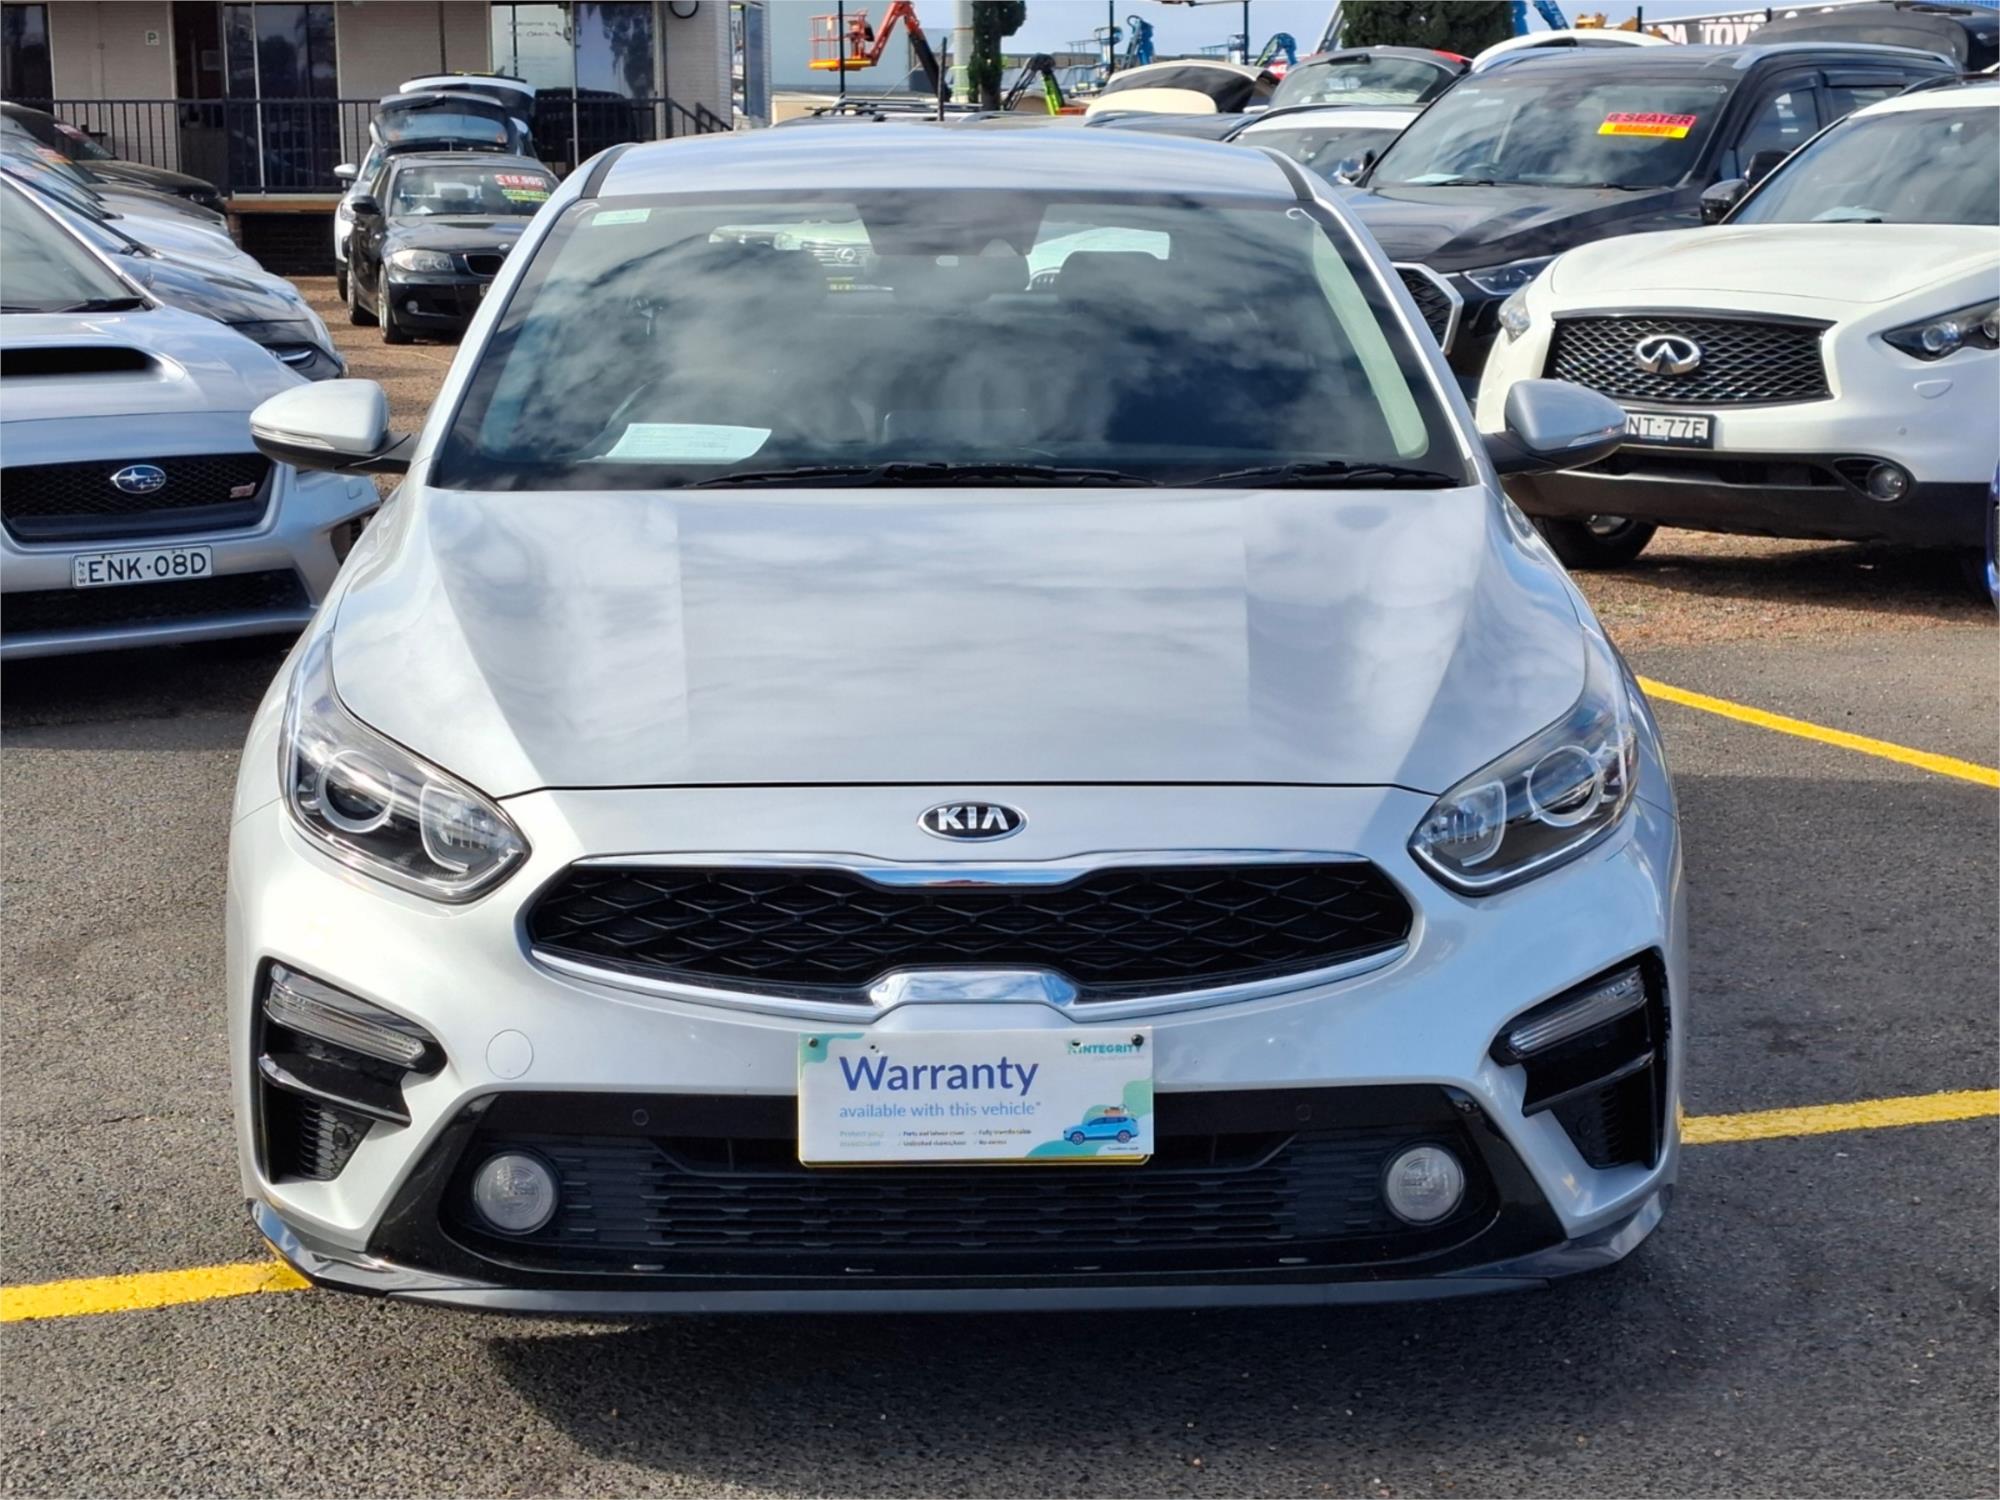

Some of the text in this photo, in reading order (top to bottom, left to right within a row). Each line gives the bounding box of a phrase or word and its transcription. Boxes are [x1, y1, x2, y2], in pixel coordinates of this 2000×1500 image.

[1623, 113, 1692, 125] SEATER
[937, 806, 1009, 831] KIA
[839, 1055, 1039, 1096] Warranty
[839, 1103, 906, 1118] available
[911, 1103, 945, 1118] with
[949, 1102, 977, 1117] this
